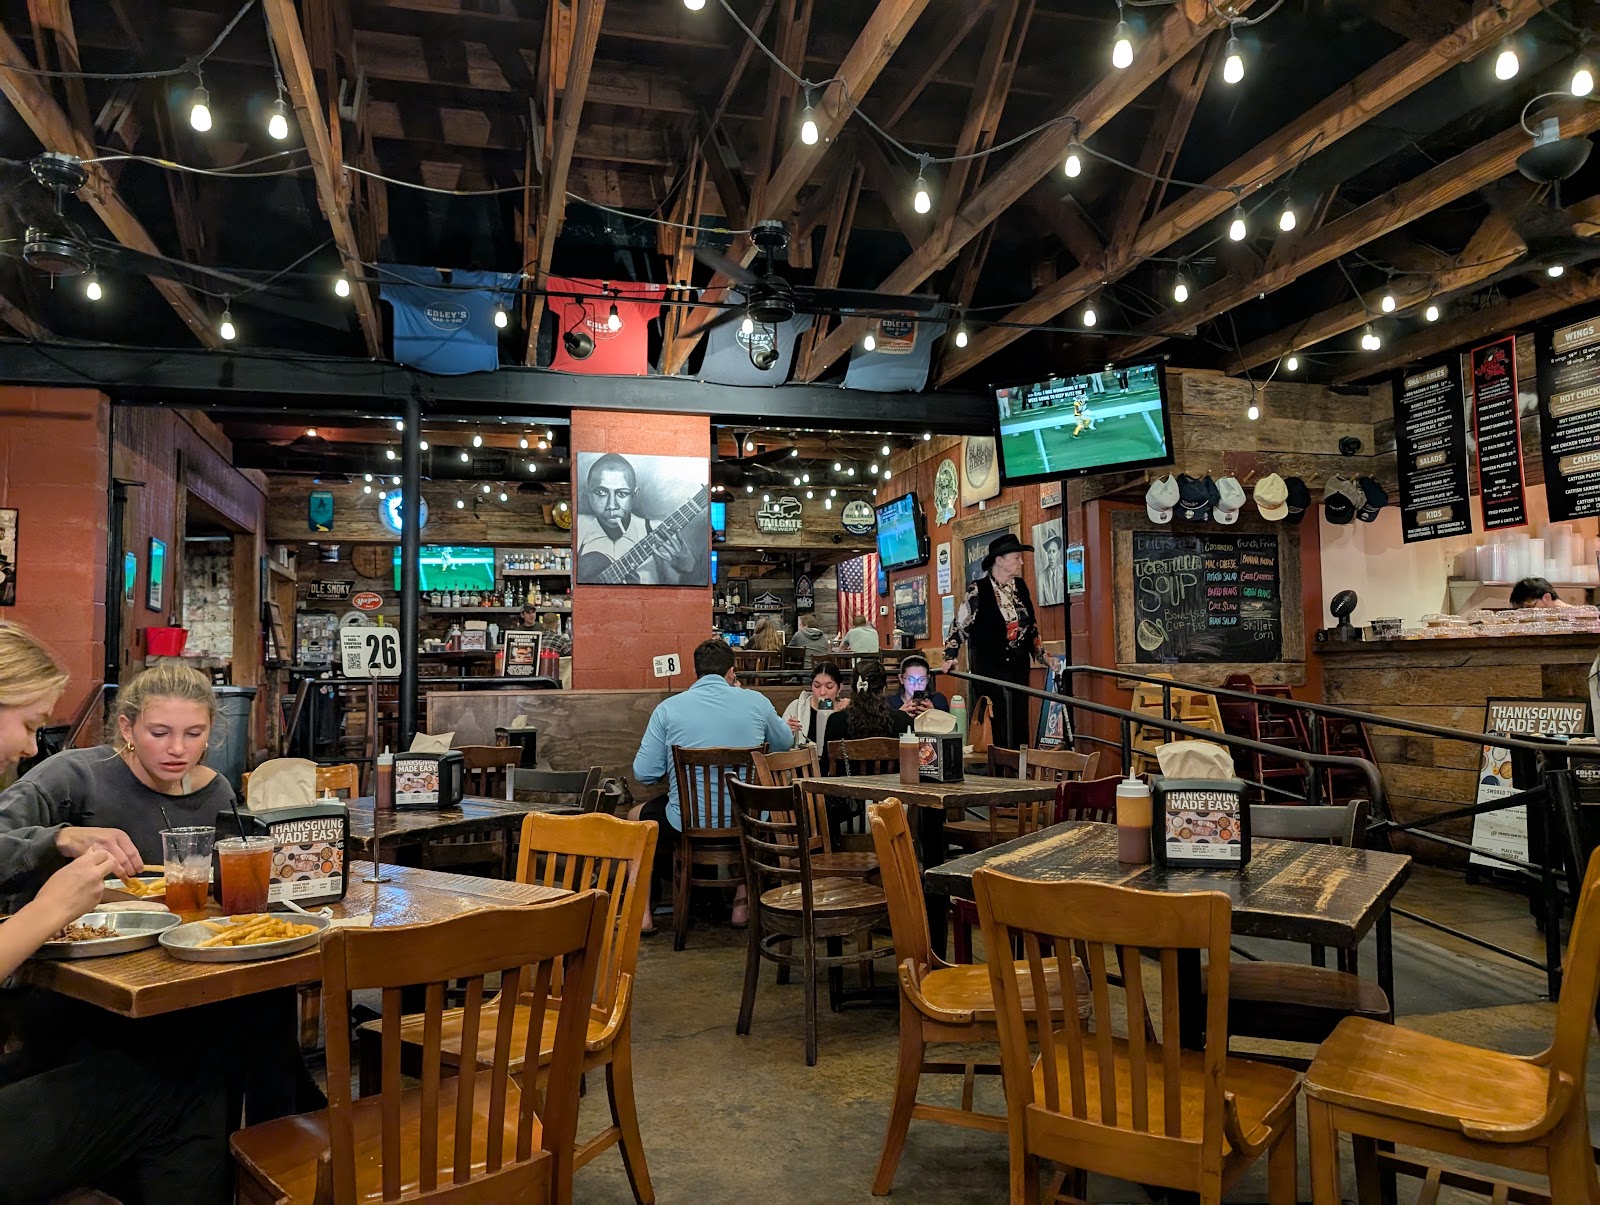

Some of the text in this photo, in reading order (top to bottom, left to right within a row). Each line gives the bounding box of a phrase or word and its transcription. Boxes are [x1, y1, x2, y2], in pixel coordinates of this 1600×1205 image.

[427, 309, 466, 318] EDLEY'S
[1565, 326, 1594, 342] WINGS
[1408, 370, 1444, 386] SHAREABLES
[1560, 394, 1575, 403] HOT
[1568, 414, 1586, 422] CHICKEN
[1560, 439, 1578, 448] CHICKEN
[970, 453, 989, 470] ABBEY
[1420, 454, 1442, 466] SALADS
[1426, 510, 1442, 519] KIDS
[758, 518, 802, 528] TAILGATE
[1260, 539, 1276, 548] Fries
[1134, 555, 1203, 577] TORTILLA
[1205, 560, 1216, 568] MAC
[1207, 572, 1237, 581] POTATO SALAD
[311, 584, 350, 594] OLE SMOKY
[1138, 573, 1197, 612] SOUP
[1208, 586, 1237, 596] BAKED BEANS
[1243, 587, 1271, 598] GREEN BEANS
[1209, 601, 1221, 610] COLE
[1222, 616, 1237, 625] SALAD
[366, 634, 396, 669] 26
[668, 658, 675, 672] 8
[1491, 706, 1582, 720] THANKSGIVING
[1496, 719, 1578, 734] MADE EASY
[1172, 800, 1238, 810] MADE EASY
[274, 829, 342, 844] MADE EASY
